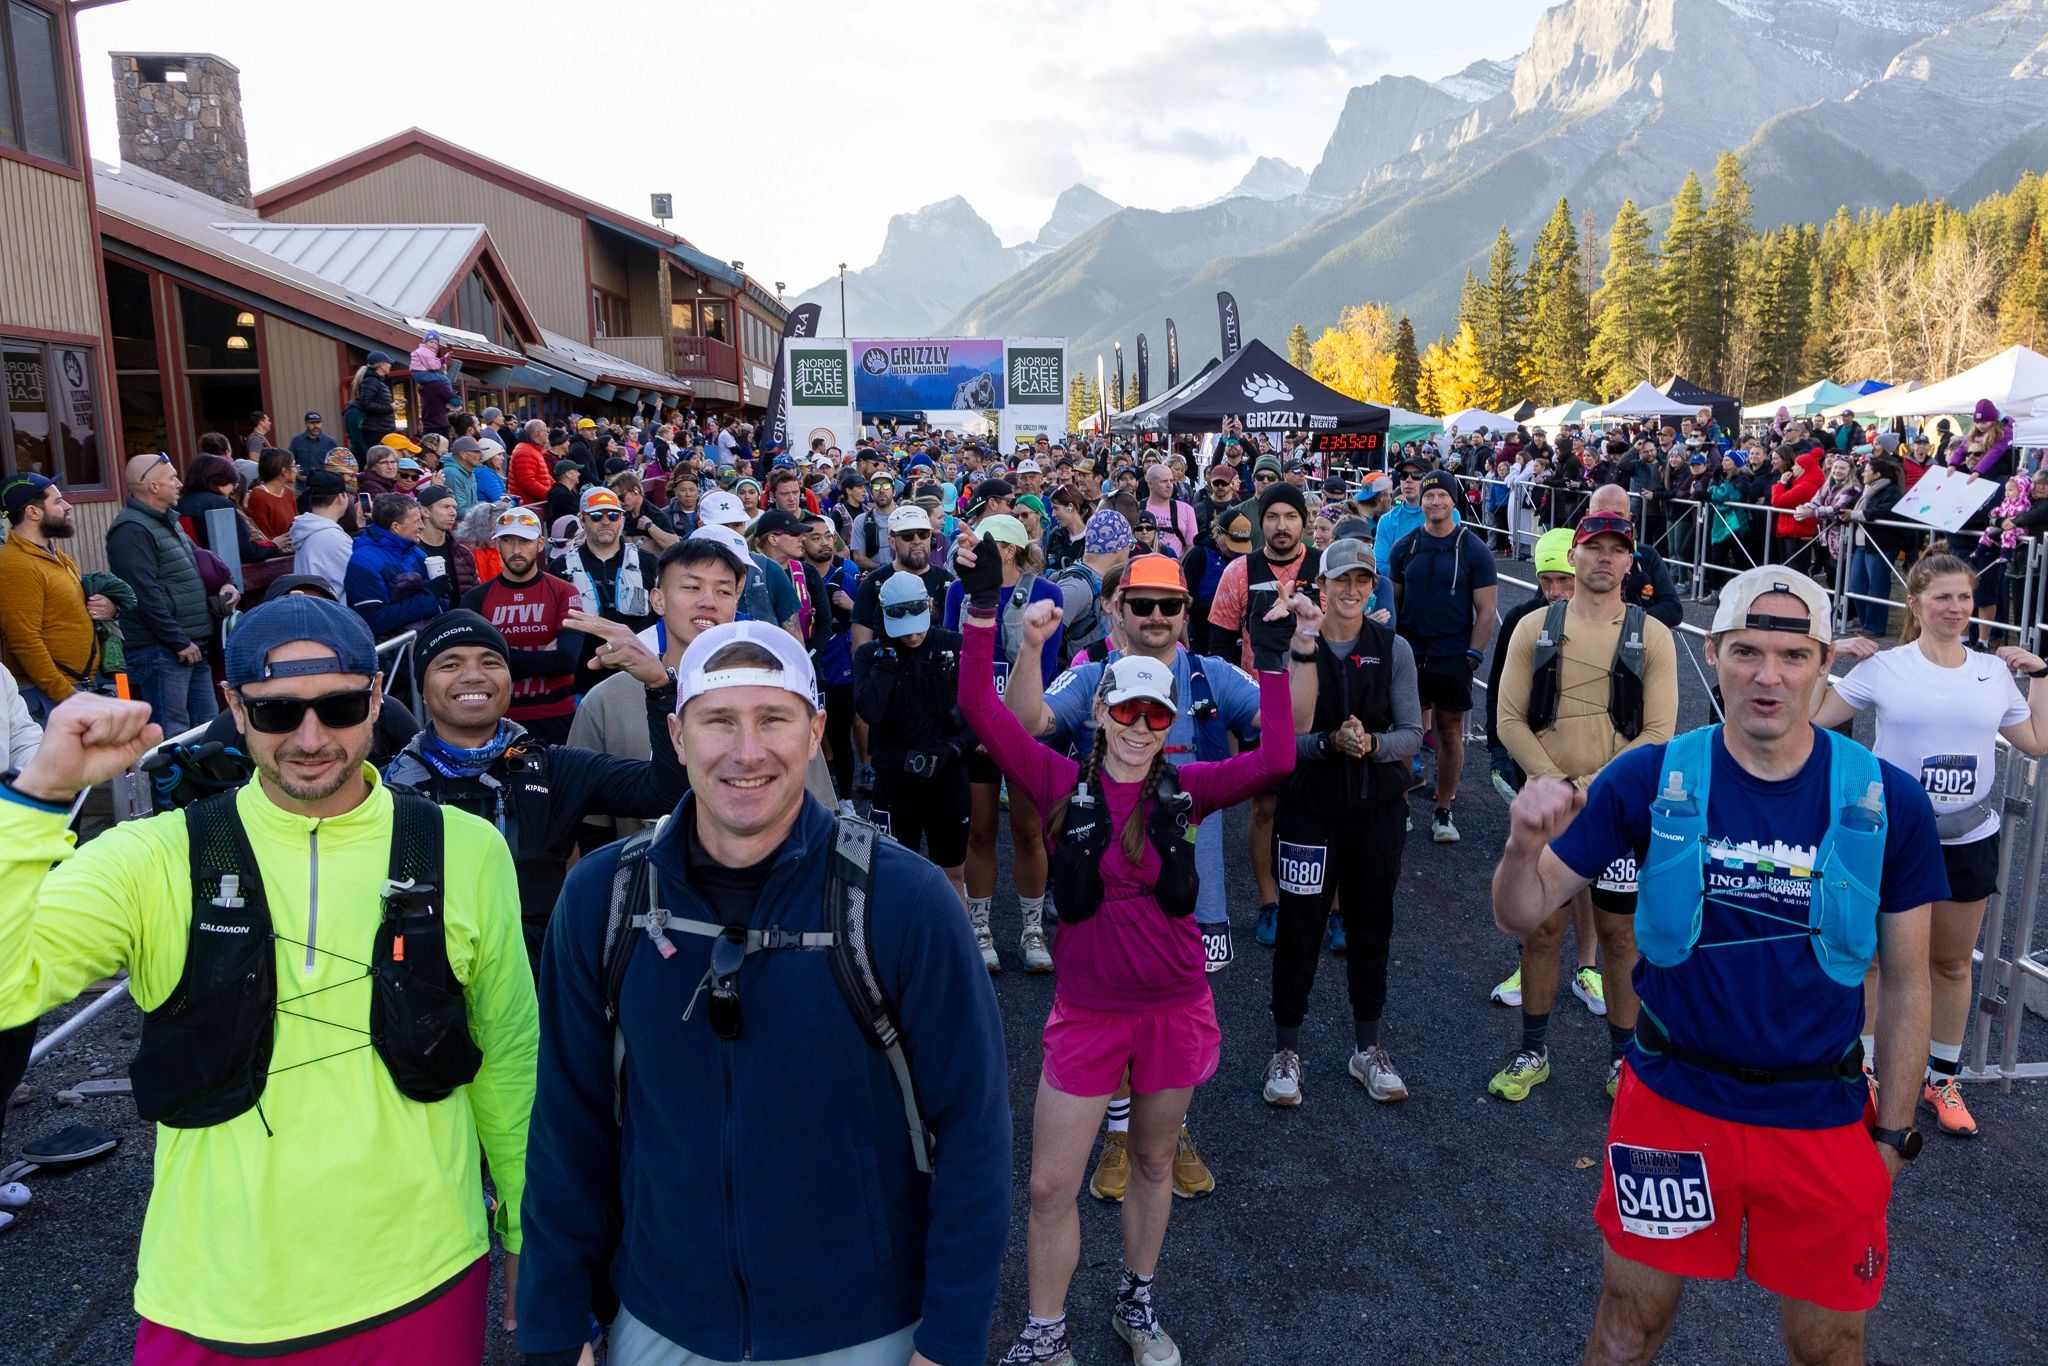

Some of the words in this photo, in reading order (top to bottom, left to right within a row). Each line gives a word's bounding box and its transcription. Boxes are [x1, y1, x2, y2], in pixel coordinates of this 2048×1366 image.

[890, 346, 951, 366] GRIZZLY
[1020, 357, 1059, 367] NORDIC
[803, 359, 842, 368] NORDIC
[891, 366, 911, 375] ULTRA
[912, 365, 948, 375] MARATHON
[803, 368, 842, 381] TREE
[1020, 367, 1059, 380] TREE
[803, 382, 843, 394] CARE
[1020, 380, 1059, 393] CARE
[1246, 411, 1305, 428] GRIZZLY
[1309, 420, 1338, 428] EVENTS
[1319, 435, 1377, 450] 23:55:28
[429, 626, 473, 647] DIADORA
[1923, 768, 1973, 793] T902
[525, 784, 549, 794] KIPRUN
[1281, 857, 1322, 884] T680
[1709, 873, 1744, 888] ING
[1726, 890, 1743, 898] VALLEY
[199, 922, 250, 934] SALOMON
[1629, 1149, 1681, 1168] GRIZZLY
[1619, 1173, 1707, 1219] S405
